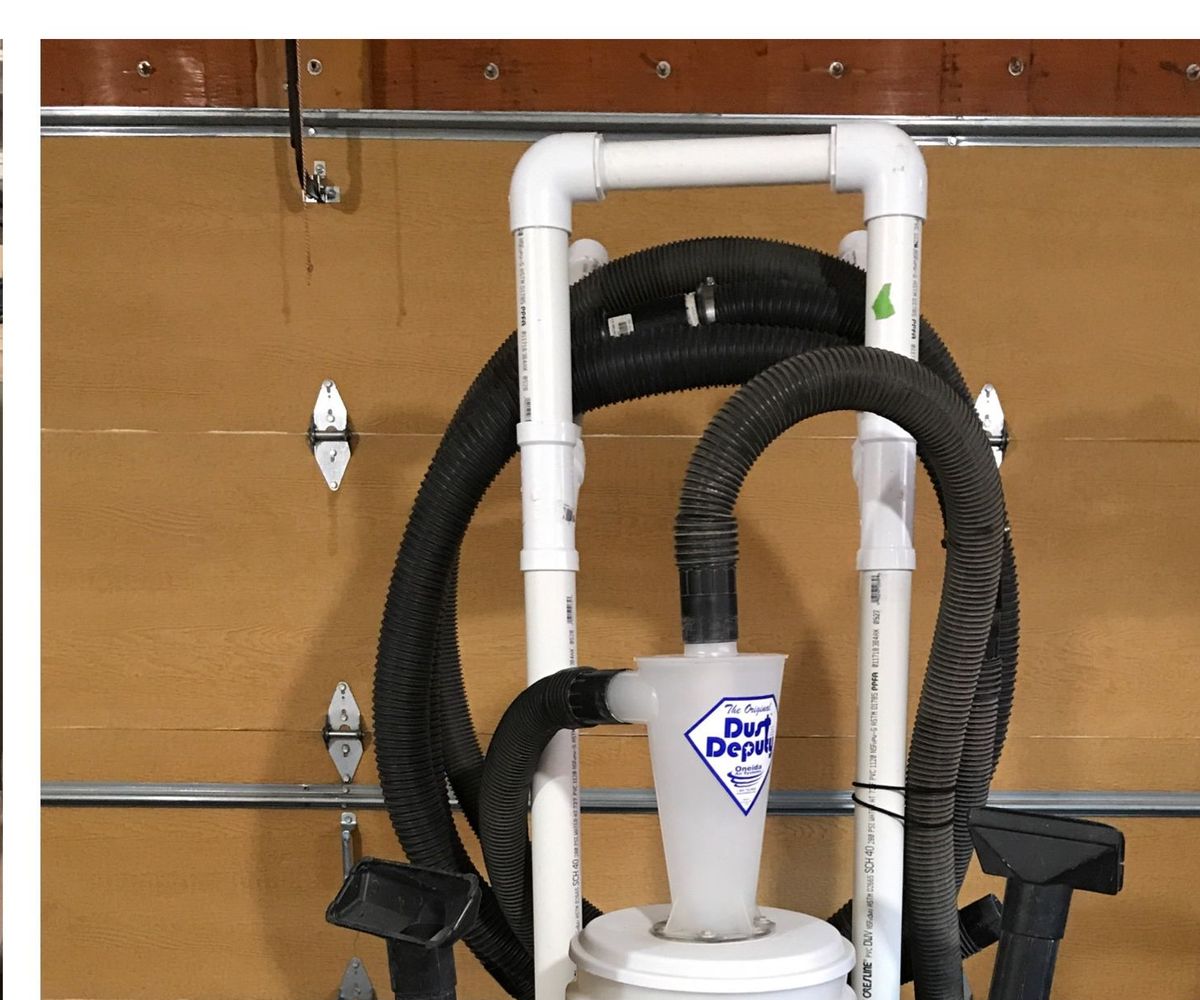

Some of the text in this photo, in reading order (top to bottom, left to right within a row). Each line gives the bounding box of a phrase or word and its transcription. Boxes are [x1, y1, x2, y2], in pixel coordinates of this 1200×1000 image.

[724, 703, 772, 717] The Original
[724, 714, 772, 738] Dust
[705, 736, 774, 763] Deputy
[735, 764, 762, 773] Oneida
[864, 845, 874, 857] 40
[864, 858, 874, 873] SCH
